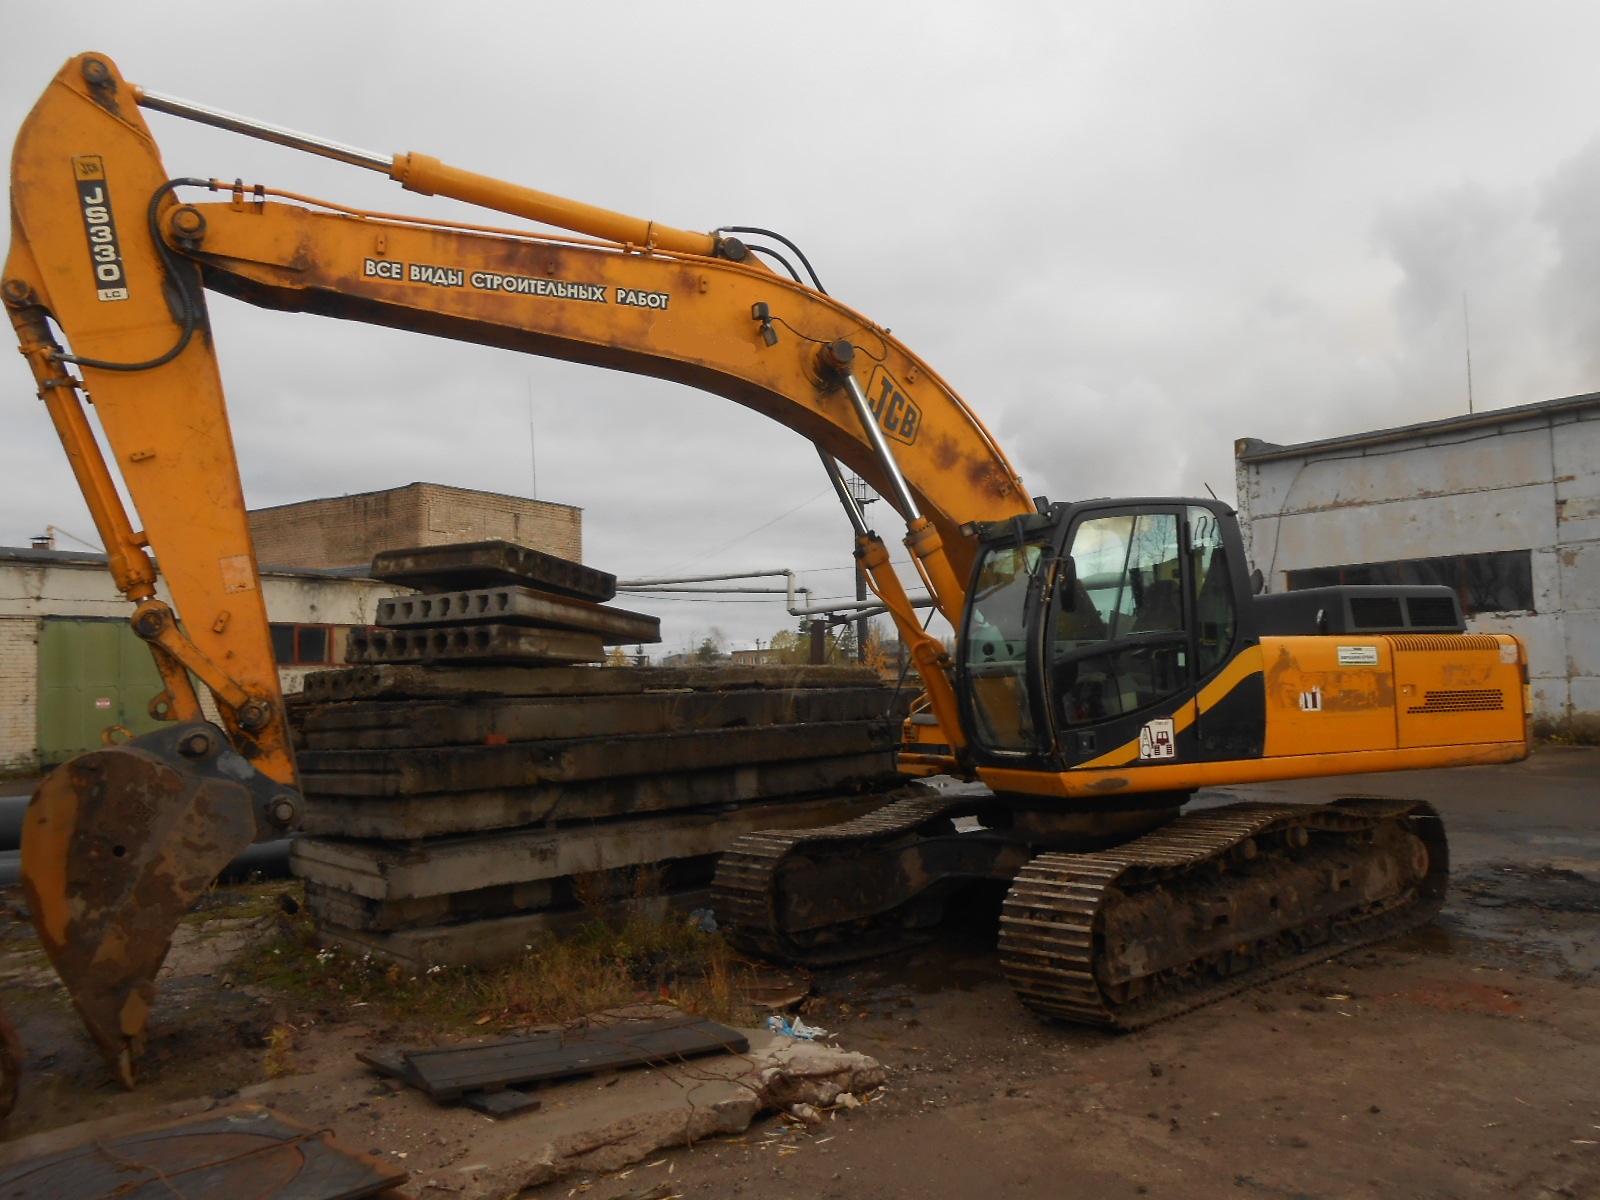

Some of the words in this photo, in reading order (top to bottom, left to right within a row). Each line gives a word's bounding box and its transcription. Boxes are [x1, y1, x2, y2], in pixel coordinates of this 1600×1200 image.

[84, 186, 121, 282] JS330
[104, 290, 122, 299] LC
[364, 258, 402, 279] ВСЕ
[409, 263, 464, 286] ВИДЫ
[470, 272, 605, 303] СТРОИТЕЛЬНЫХ
[616, 287, 669, 310] РАБОТ
[867, 375, 918, 439] JCB
